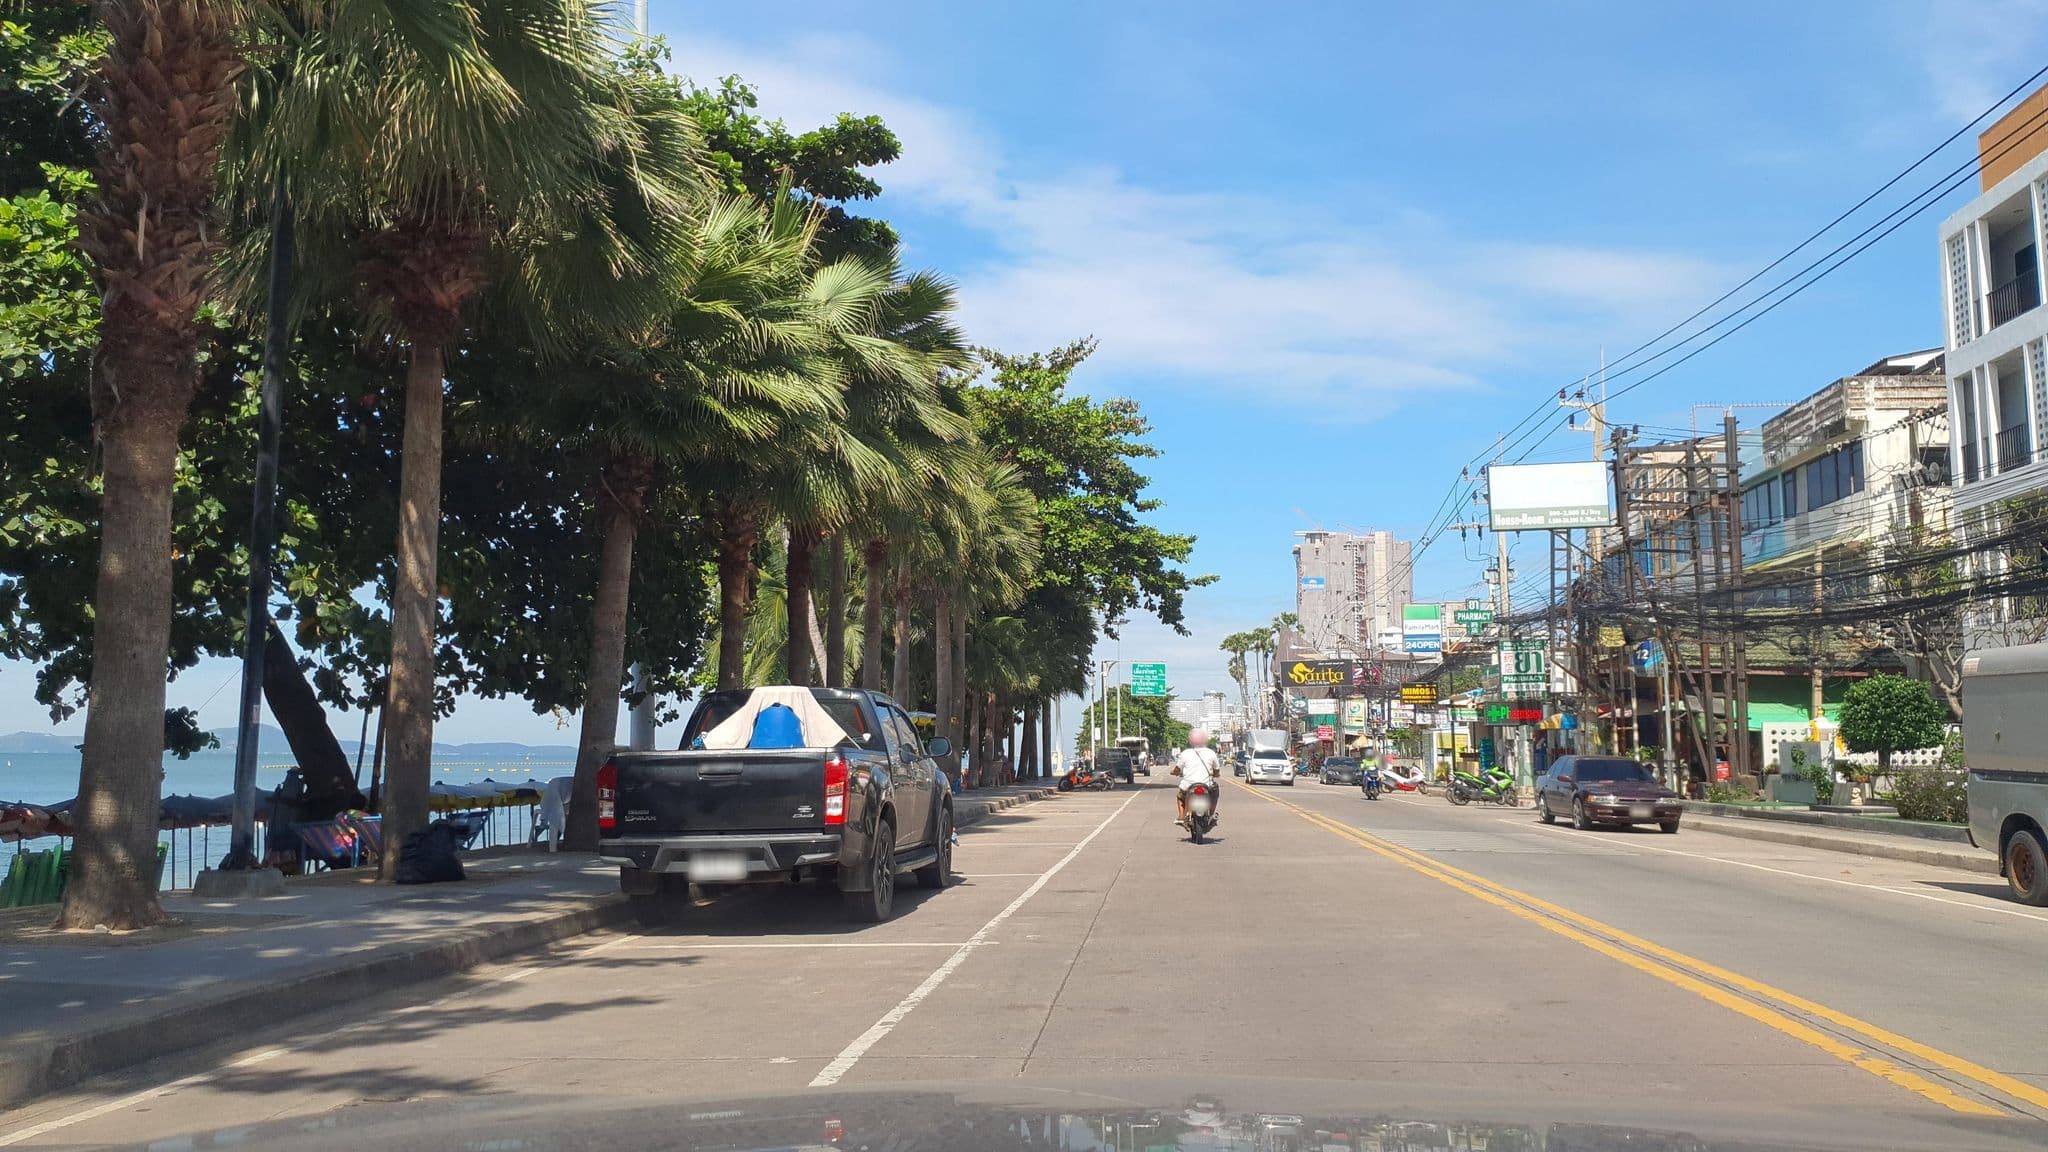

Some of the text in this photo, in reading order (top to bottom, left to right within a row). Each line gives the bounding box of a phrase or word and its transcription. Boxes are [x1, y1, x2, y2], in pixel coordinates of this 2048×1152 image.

[1457, 612, 1491, 621] PHARMACY
[1405, 623, 1440, 632] FamilyMart
[1636, 649, 1649, 660] 12
[1402, 687, 1437, 695] MIMOSA
